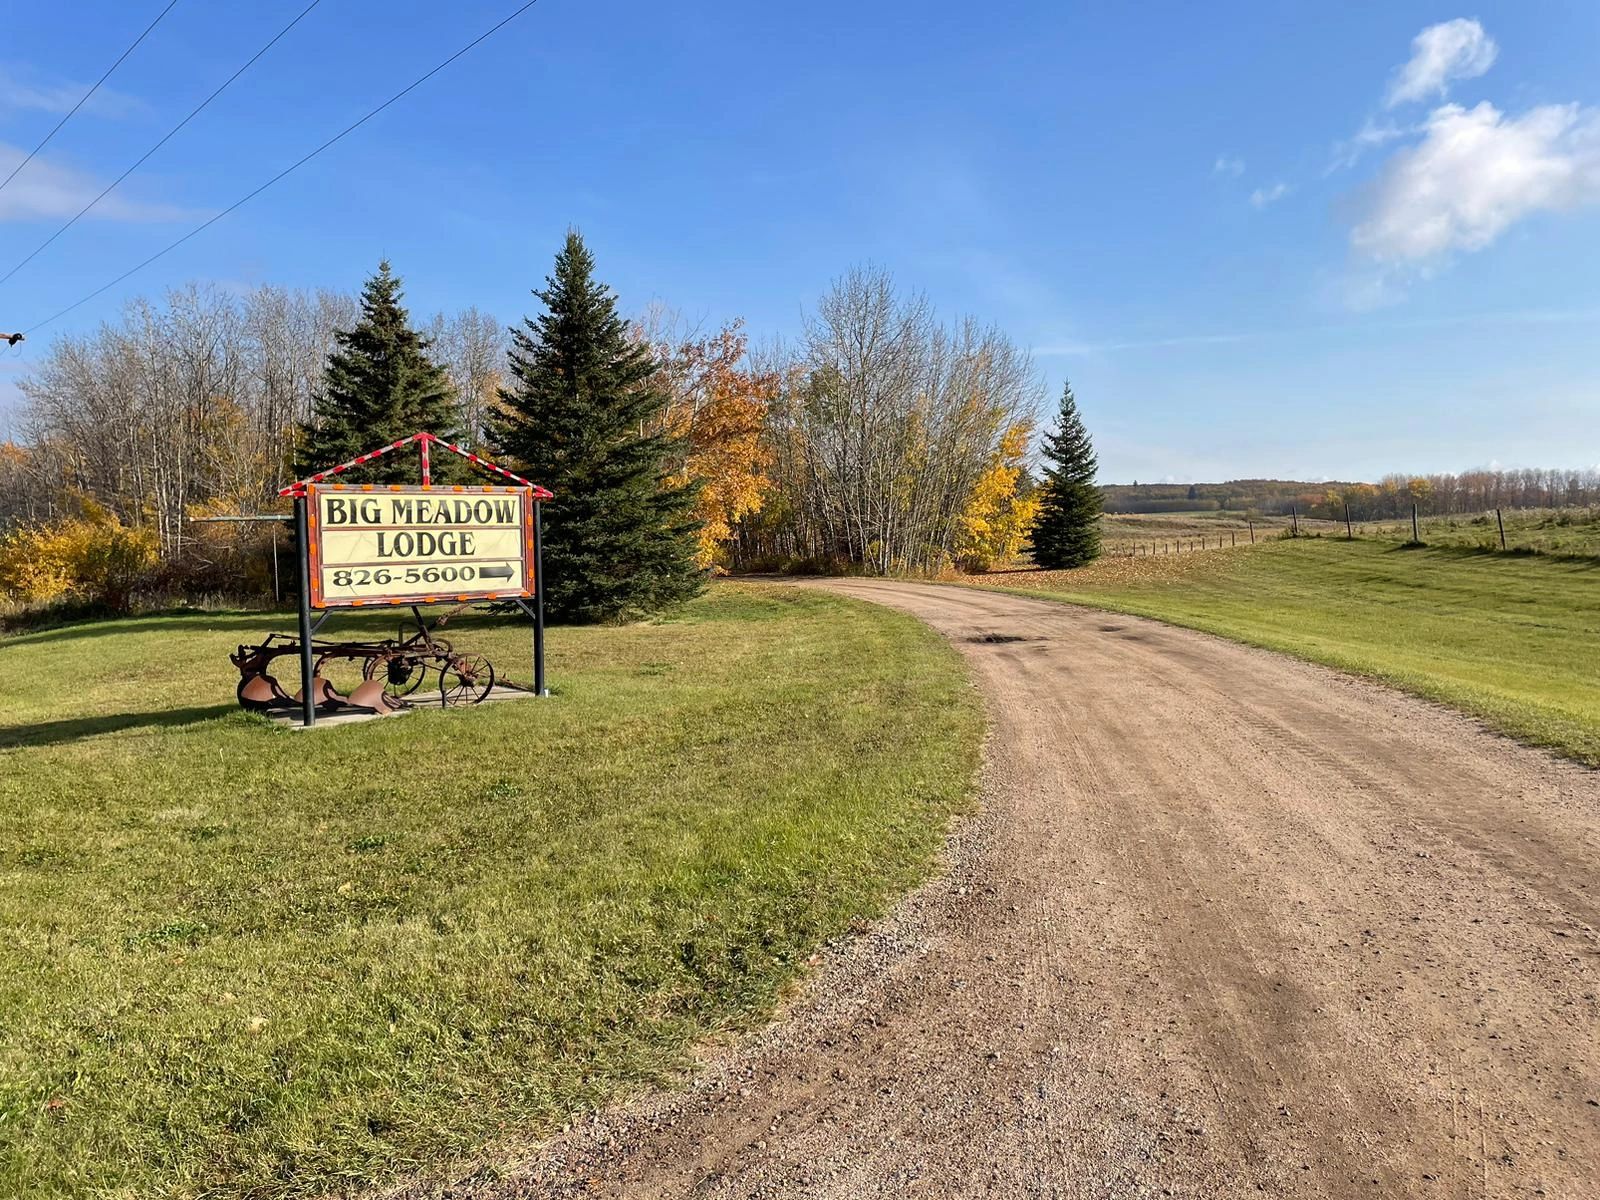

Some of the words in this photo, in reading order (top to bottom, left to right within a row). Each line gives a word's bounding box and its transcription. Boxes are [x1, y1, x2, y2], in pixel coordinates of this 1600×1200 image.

[326, 498, 382, 525] BIG
[391, 499, 516, 525] MEADOW
[376, 531, 476, 558] LODGE
[332, 566, 476, 587] 826-5600
